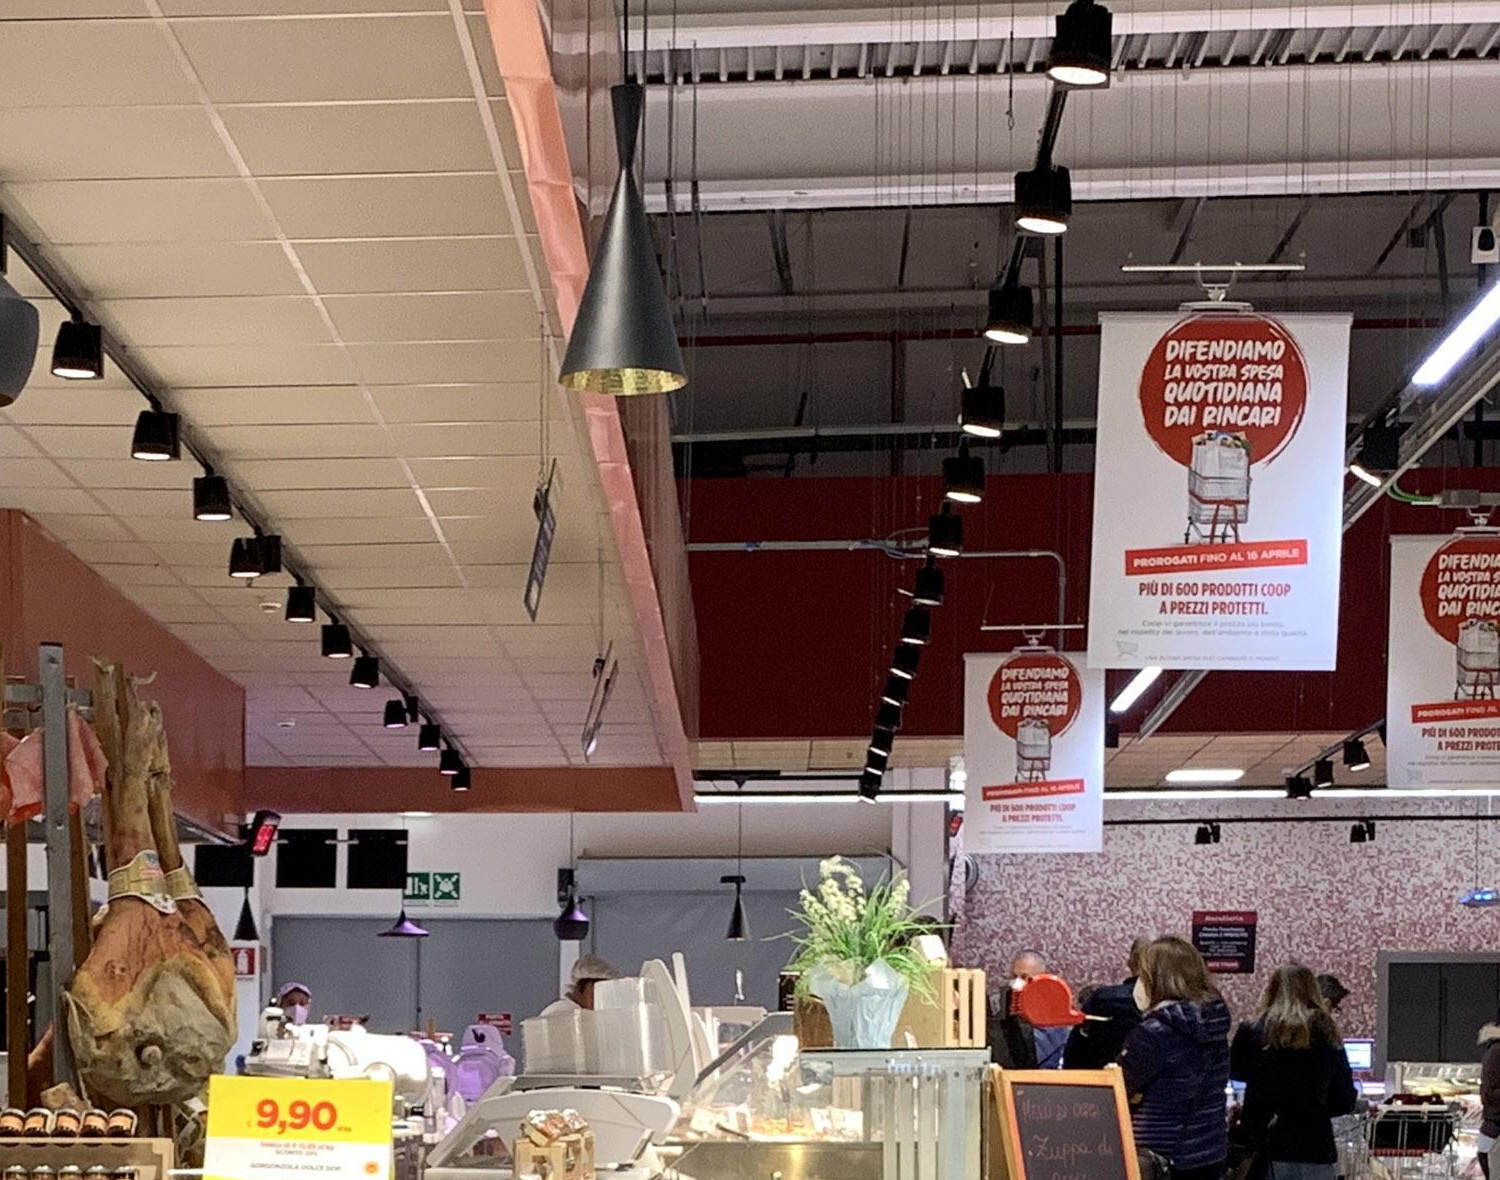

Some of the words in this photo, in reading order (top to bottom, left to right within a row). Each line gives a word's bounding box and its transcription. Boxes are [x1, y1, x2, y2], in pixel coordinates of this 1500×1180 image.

[1165, 339, 1286, 362] DIFENDIAMO
[1164, 364, 1182, 380] LA
[1185, 364, 1237, 381] VOSTRA
[1240, 364, 1284, 380] SPESA
[1163, 381, 1283, 404] QUOTIDIANA
[1164, 405, 1197, 428] DAI
[1202, 405, 1282, 428] RINCARI
[1133, 554, 1198, 568] PROROGATI
[1200, 552, 1226, 564] FINO
[1229, 552, 1244, 561] AL
[1260, 548, 1300, 560] APRILE
[1139, 580, 1158, 596] PIÙ
[1161, 582, 1173, 596] DI
[1176, 582, 1198, 596] 600
[1202, 583, 1258, 596] PRODOTTI
[1261, 584, 1291, 597] COOP
[1159, 601, 1167, 615] A
[1170, 601, 1209, 615] PREZZI
[1212, 602, 1269, 615] PROTETTI.
[1438, 600, 1462, 617] DAI
[256, 1098, 338, 1135] 9,90
[250, 1162, 299, 1170] GORGONZOLA
